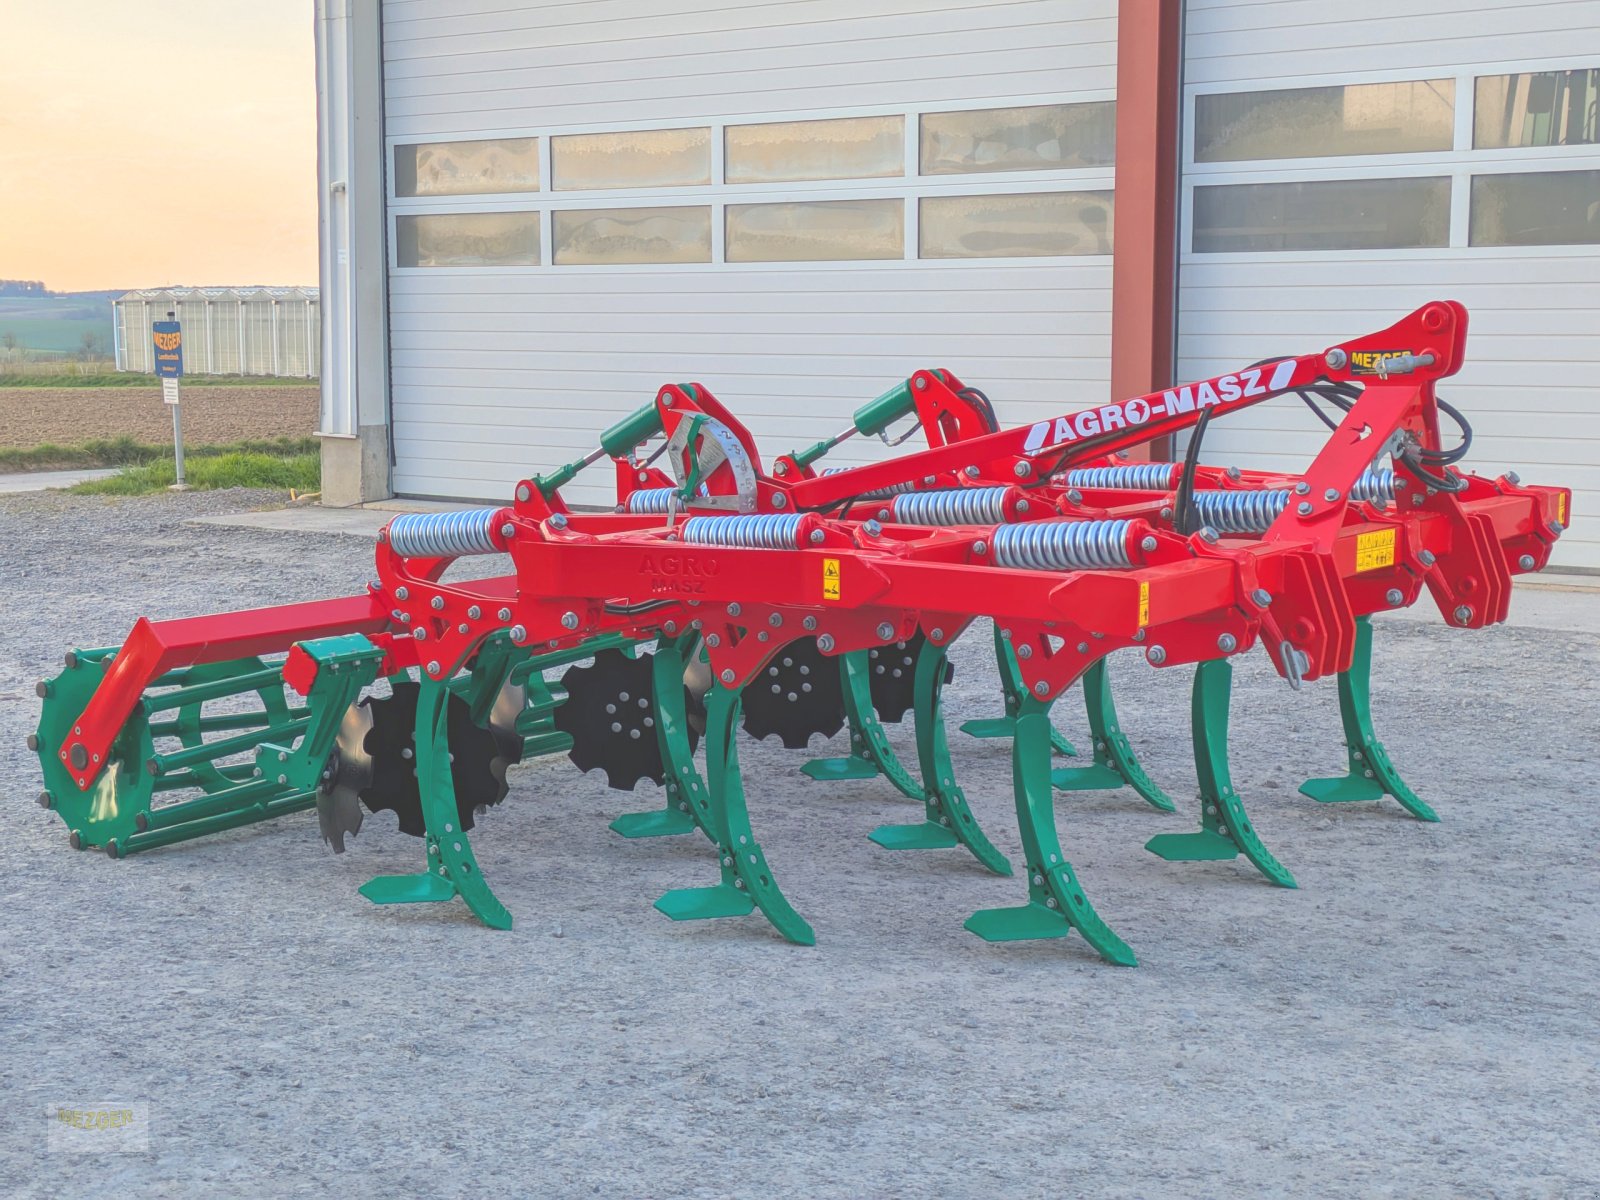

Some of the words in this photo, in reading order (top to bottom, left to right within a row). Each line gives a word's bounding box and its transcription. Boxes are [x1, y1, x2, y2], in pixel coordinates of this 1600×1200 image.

[153, 331, 181, 351] MEZGER
[1053, 368, 1266, 444] AGRO-MASZ
[721, 430, 732, 440] 2
[639, 554, 720, 578] AGRO
[651, 578, 706, 595] MASZ
